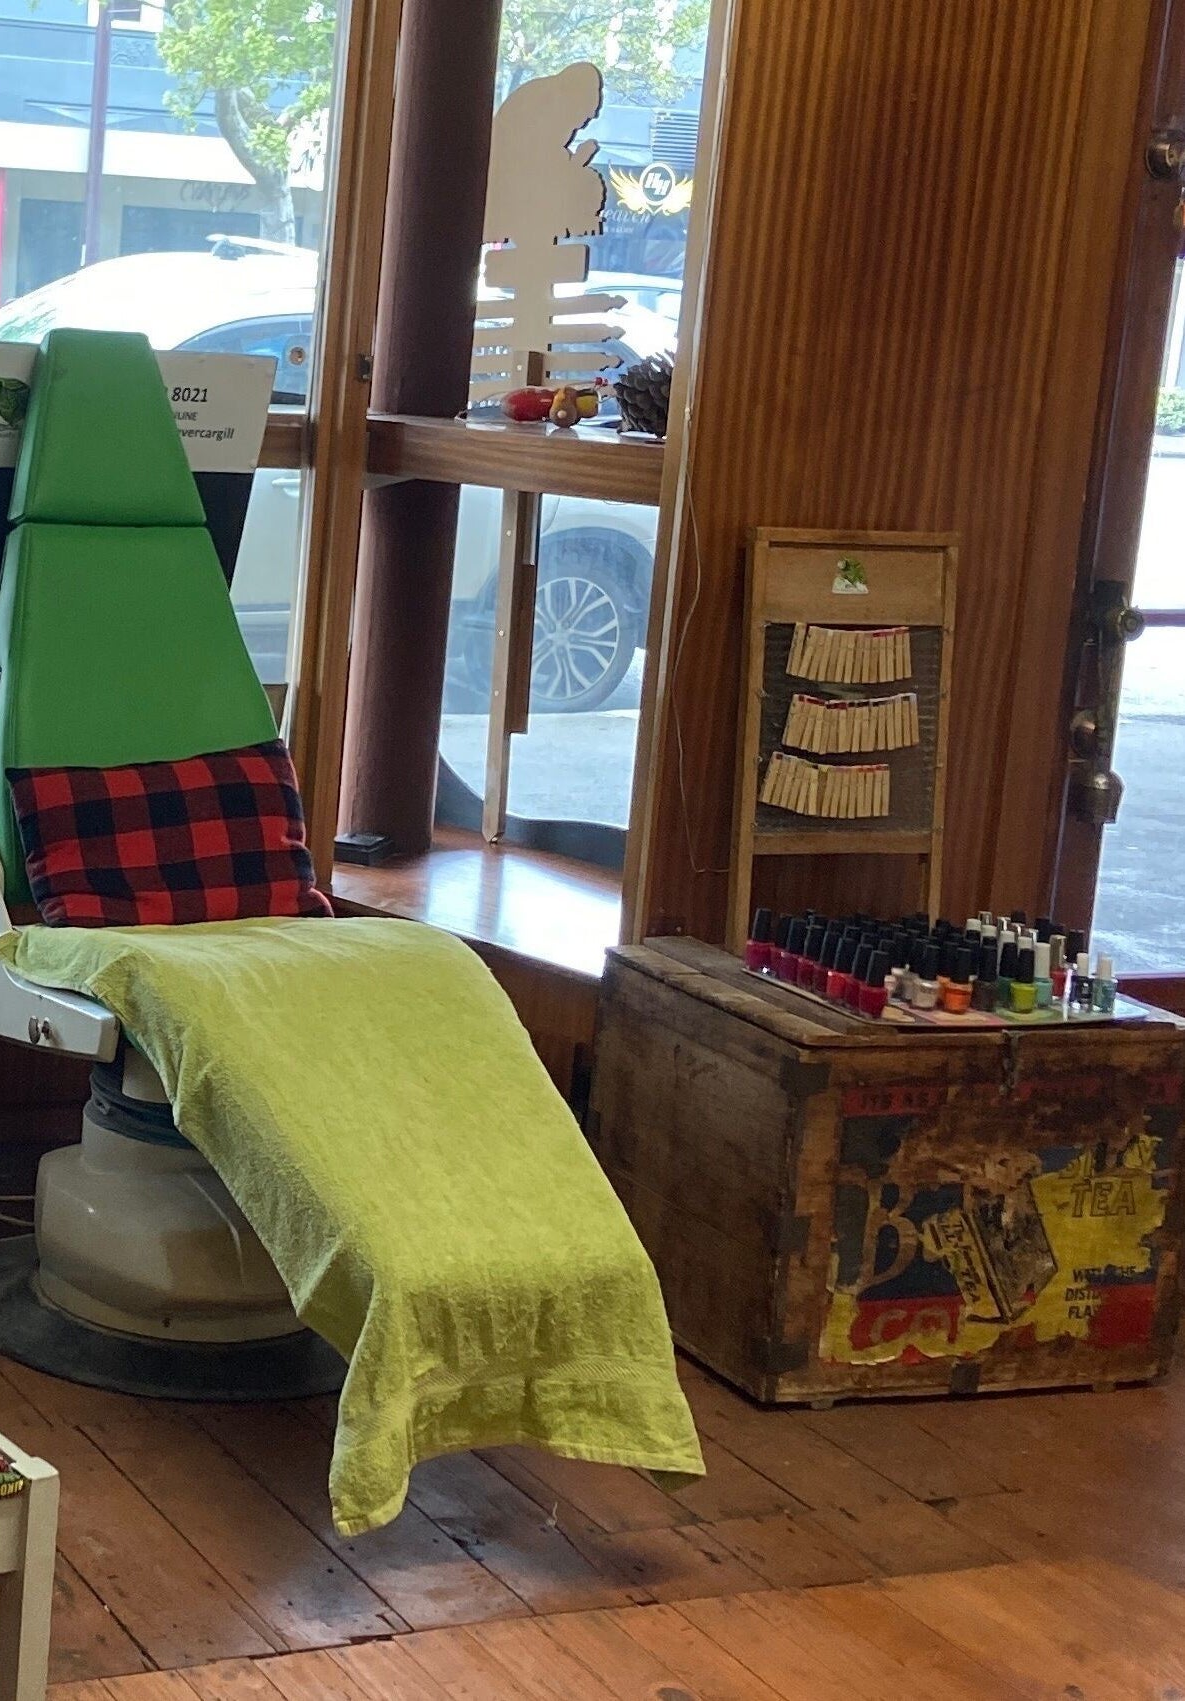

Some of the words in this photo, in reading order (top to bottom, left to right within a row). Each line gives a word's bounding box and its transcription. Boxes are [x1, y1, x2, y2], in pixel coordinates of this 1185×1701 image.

[171, 386, 208, 403] 8021
[178, 427, 235, 442] vercargill
[1071, 1180, 1137, 1218] TEA
